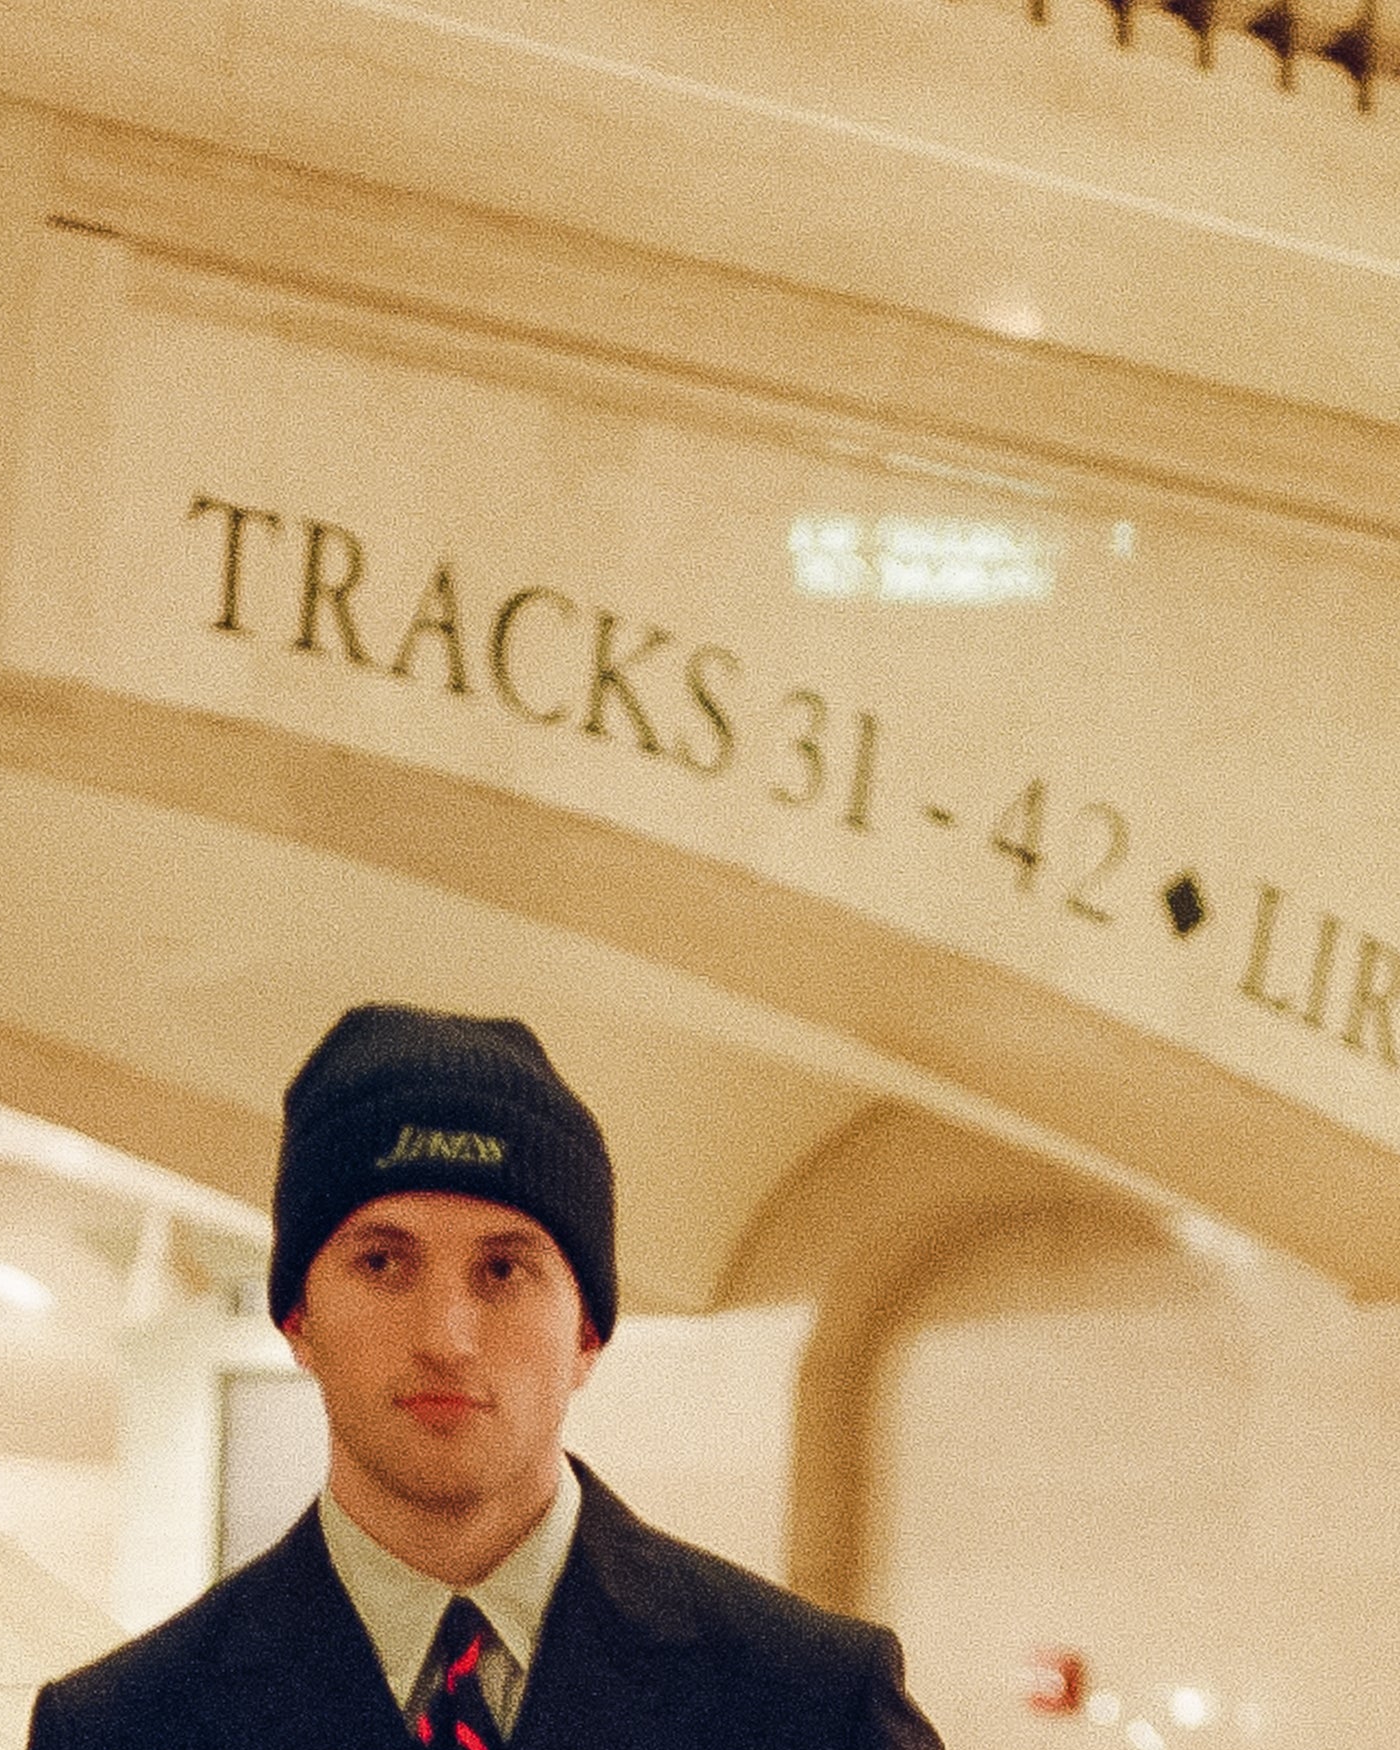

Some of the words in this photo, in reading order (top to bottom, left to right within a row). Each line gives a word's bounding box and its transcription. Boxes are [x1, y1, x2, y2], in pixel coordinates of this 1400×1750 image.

[187, 491, 744, 779] TRACKS
[766, 690, 879, 833] 31
[987, 774, 1131, 926] 42
